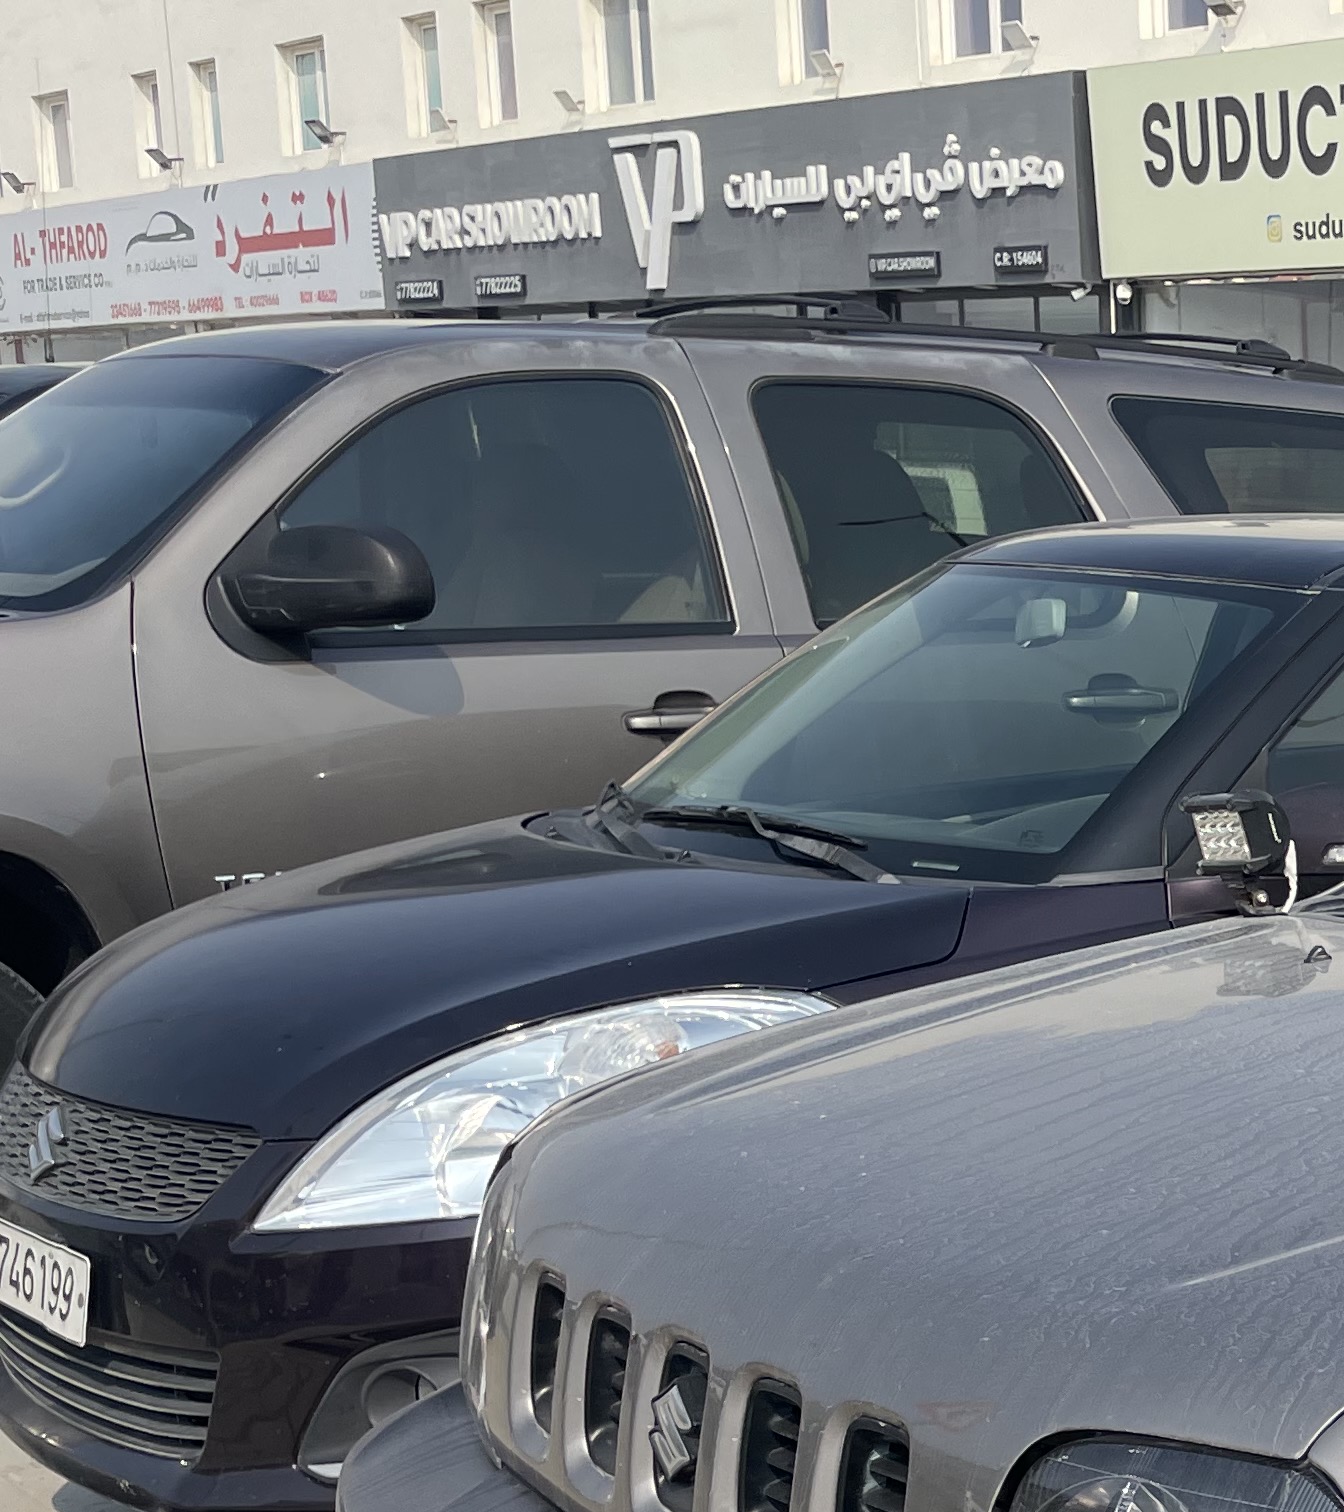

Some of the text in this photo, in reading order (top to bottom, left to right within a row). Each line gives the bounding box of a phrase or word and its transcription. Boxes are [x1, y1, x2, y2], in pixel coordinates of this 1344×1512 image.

[723, 163, 829, 219] للسيارات
[968, 146, 1065, 199] معرض
[39, 222, 108, 266] THFAROD
[215, 186, 349, 273] التفرد
[417, 206, 463, 251] CAR
[461, 193, 603, 248] SHOWROOM
